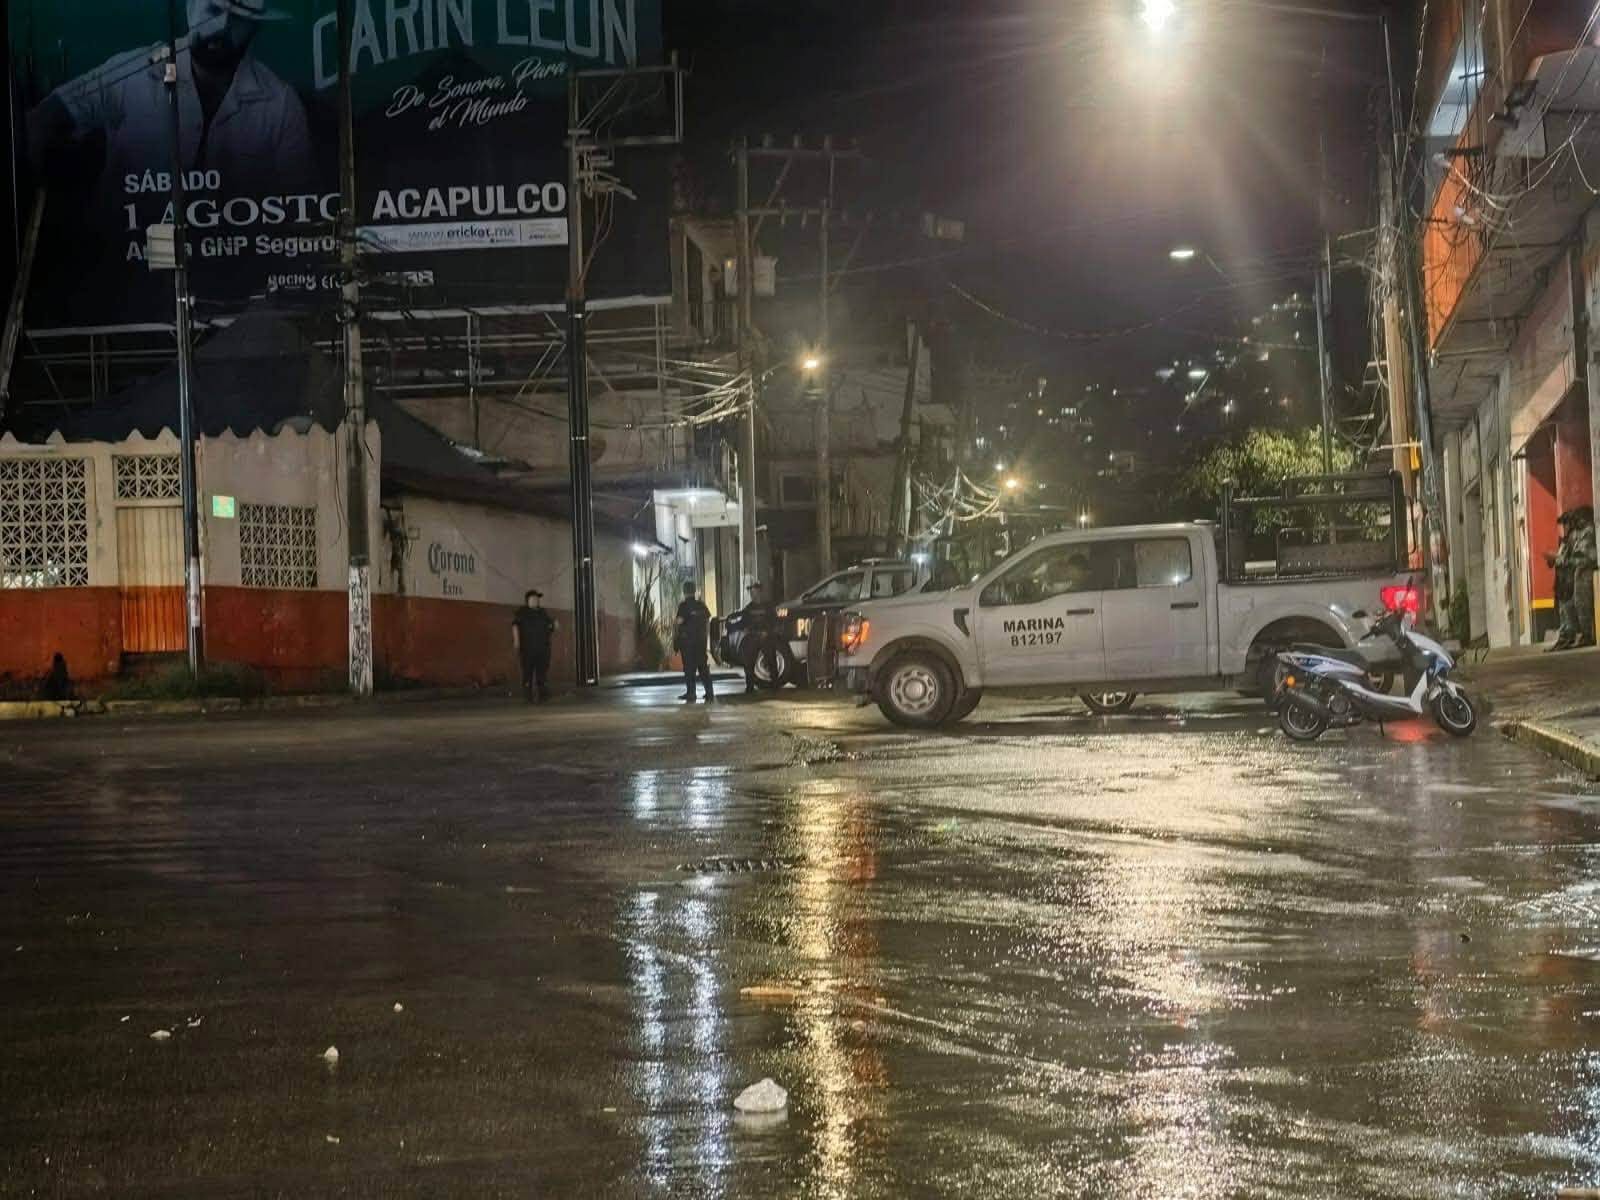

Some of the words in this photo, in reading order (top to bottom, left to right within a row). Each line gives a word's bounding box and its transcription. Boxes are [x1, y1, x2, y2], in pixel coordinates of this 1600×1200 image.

[450, 90, 530, 127] Mundo
[372, 182, 567, 219] ACAPULCO
[122, 203, 141, 232] 1
[201, 236, 248, 257] GNP
[428, 543, 475, 577] Corona
[1003, 617, 1065, 633] MARINA
[1011, 631, 1063, 648] 812197
